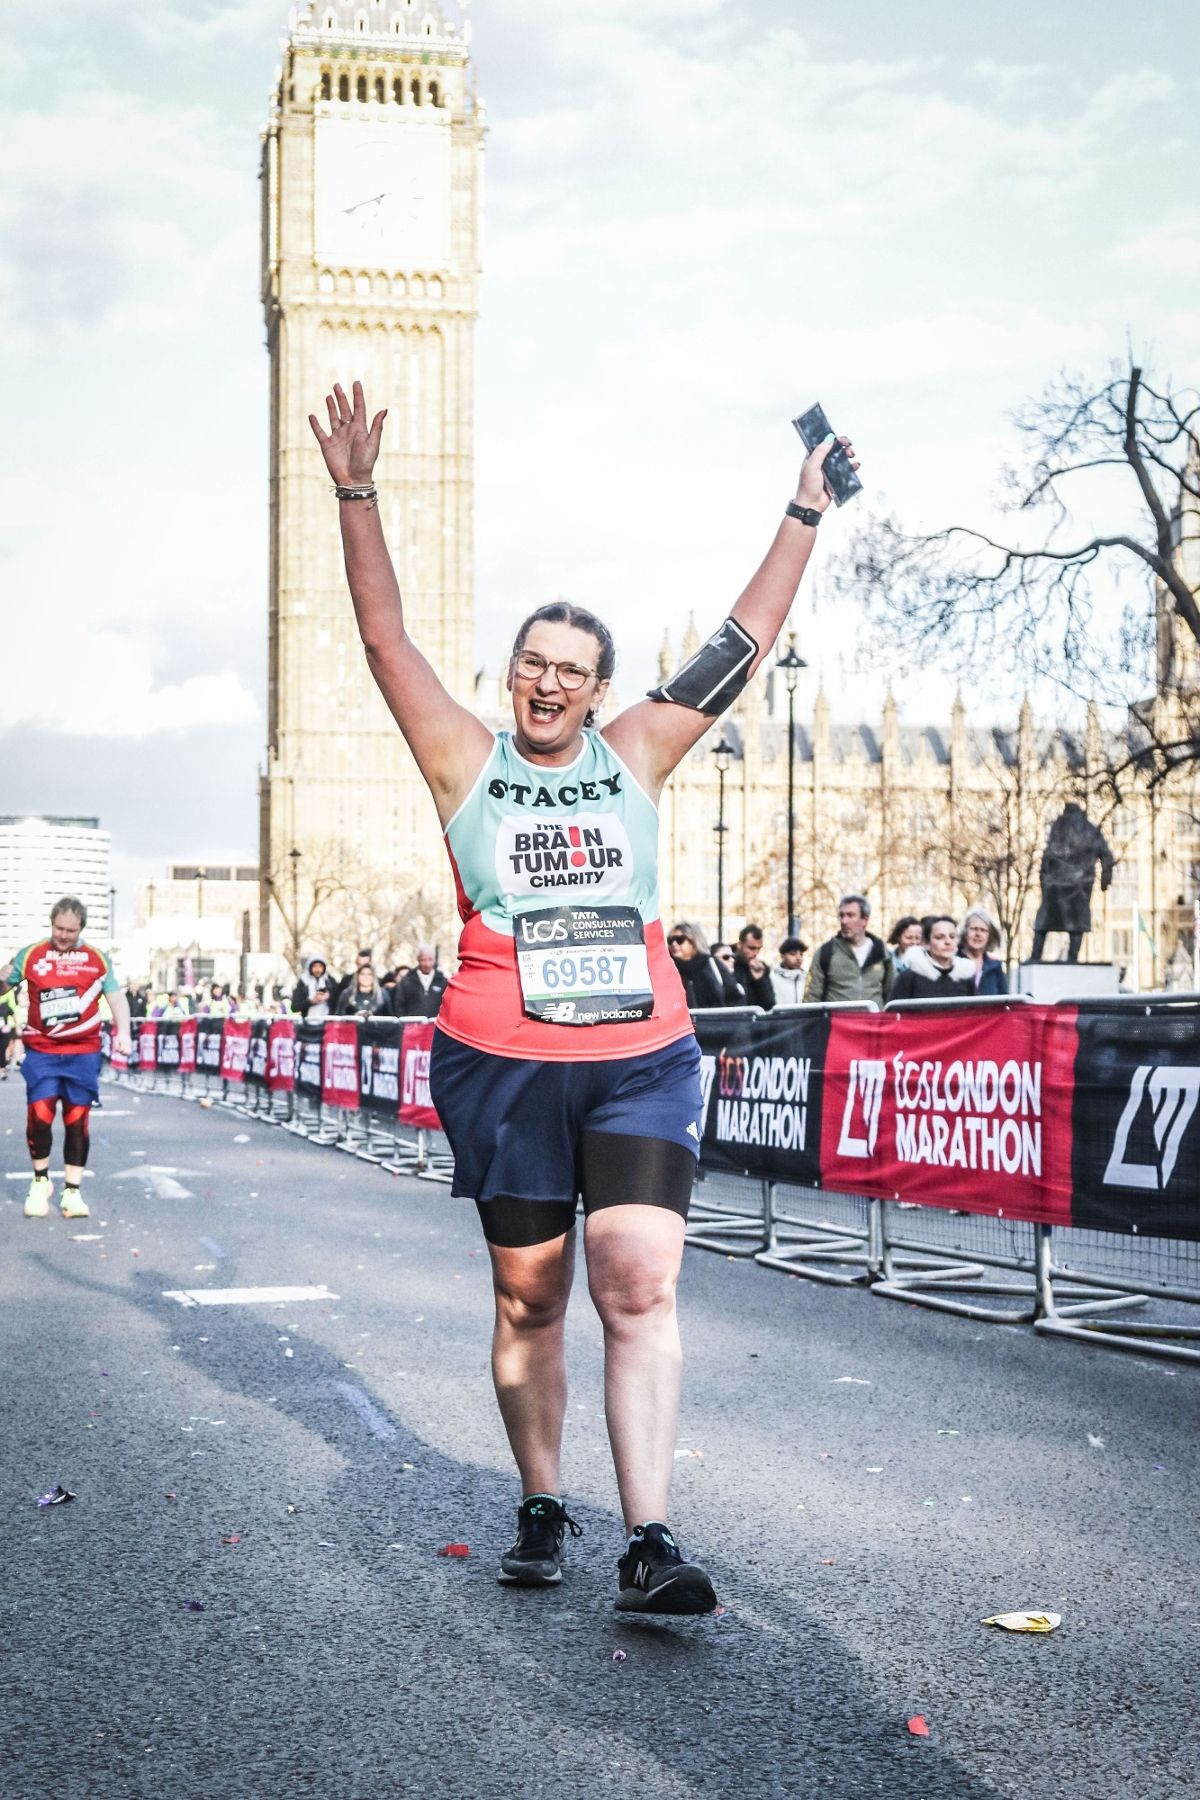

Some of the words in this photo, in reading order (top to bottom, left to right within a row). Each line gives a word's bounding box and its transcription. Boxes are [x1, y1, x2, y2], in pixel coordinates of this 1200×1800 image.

[488, 772, 622, 807] STACEY
[535, 823, 563, 831] THE
[529, 870, 605, 888] CHARITY
[571, 911, 599, 919] TATA
[572, 920, 635, 930] CONSULTANCY
[573, 929, 614, 939] SERVICES
[542, 956, 628, 988] 69587
[577, 1012, 599, 1021] new
[600, 1009, 643, 1019] balance
[741, 1056, 811, 1102] LONDON
[931, 1060, 1042, 1116] LONDON
[716, 1099, 807, 1151] MARATHON
[895, 1113, 1042, 1177] MARATHON
